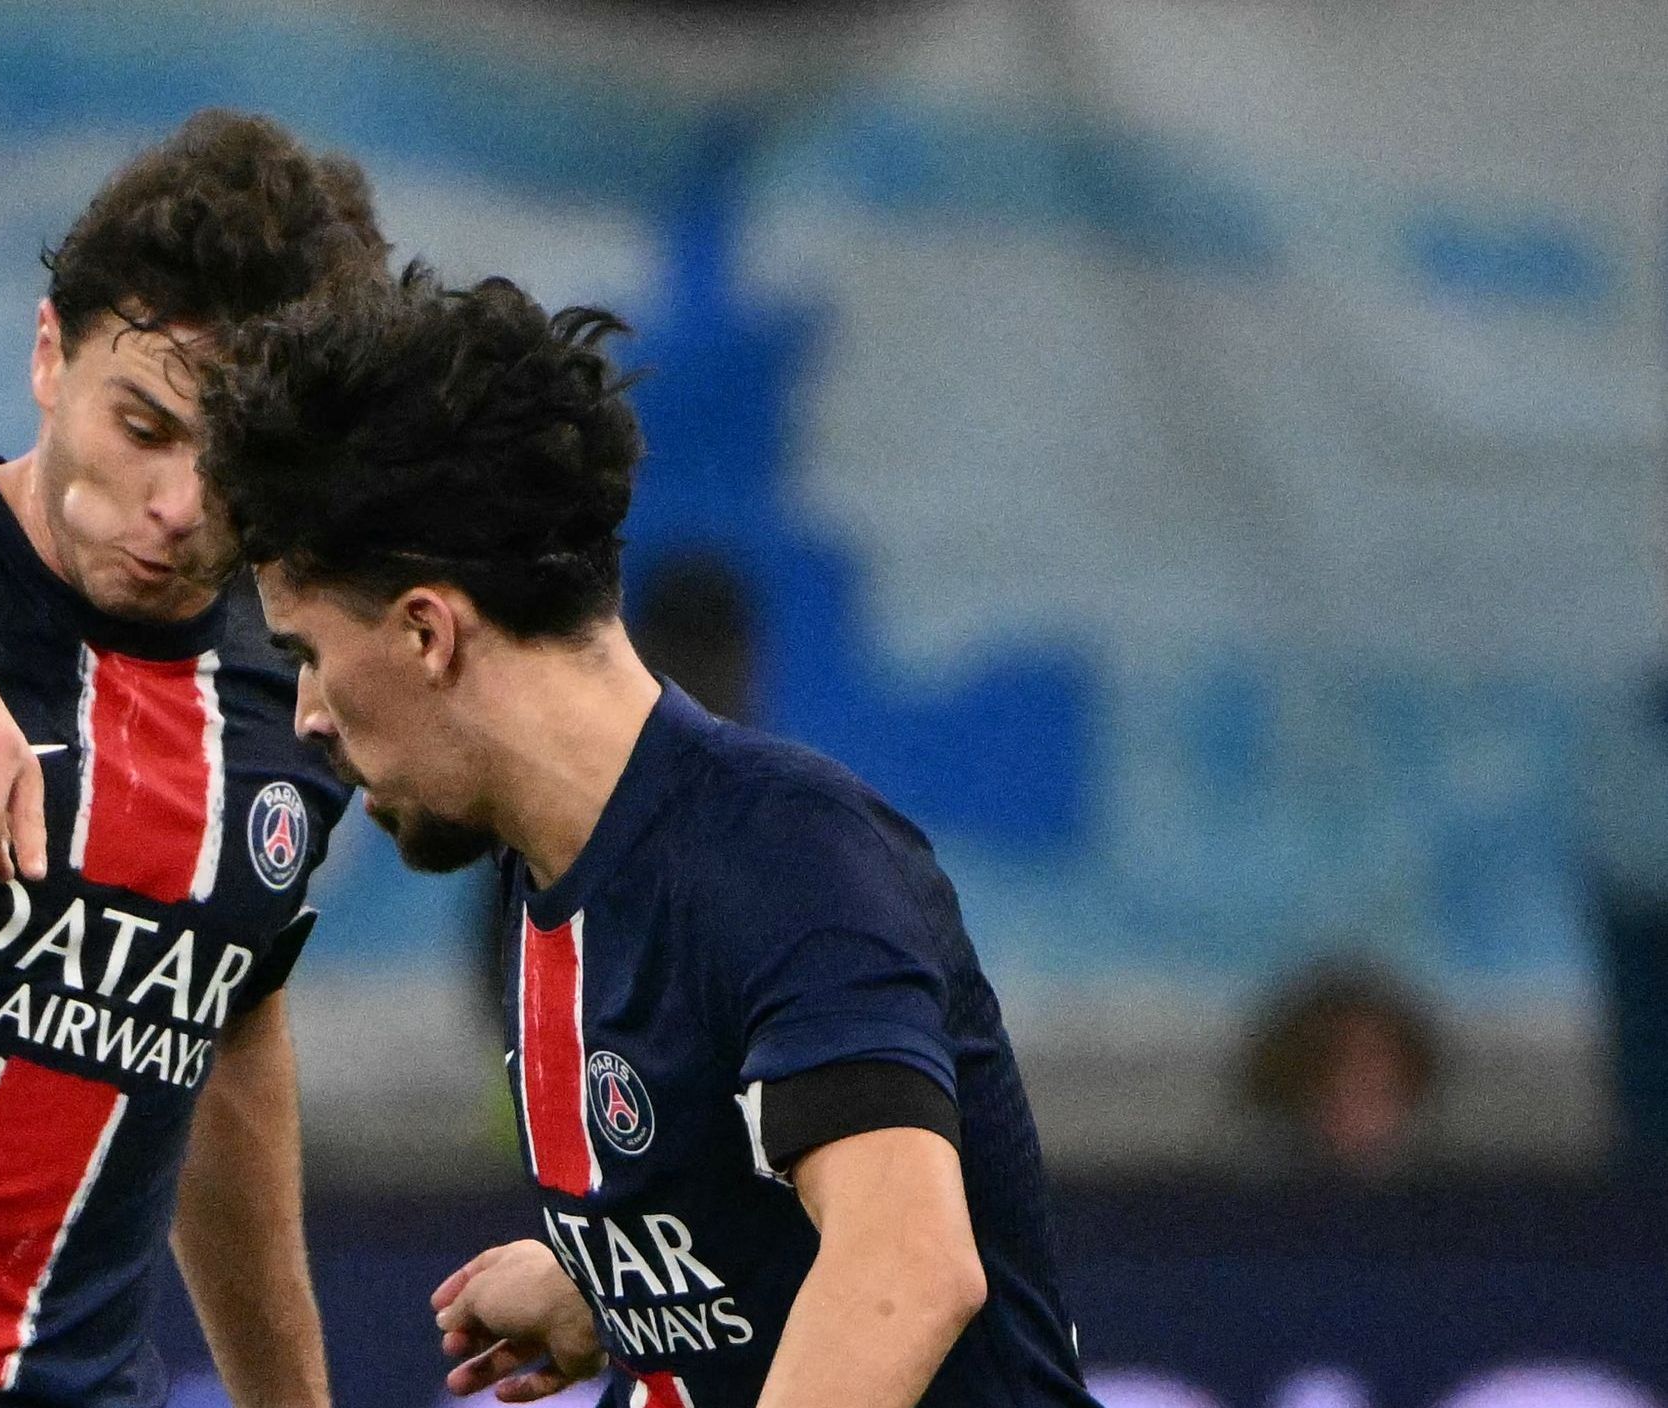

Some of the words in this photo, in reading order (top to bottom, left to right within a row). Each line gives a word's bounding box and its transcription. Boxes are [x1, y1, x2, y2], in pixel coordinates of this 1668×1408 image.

[263, 786, 301, 819] PARIS
[590, 1055, 631, 1082] PARIS
[543, 1206, 727, 1298] ATAR
